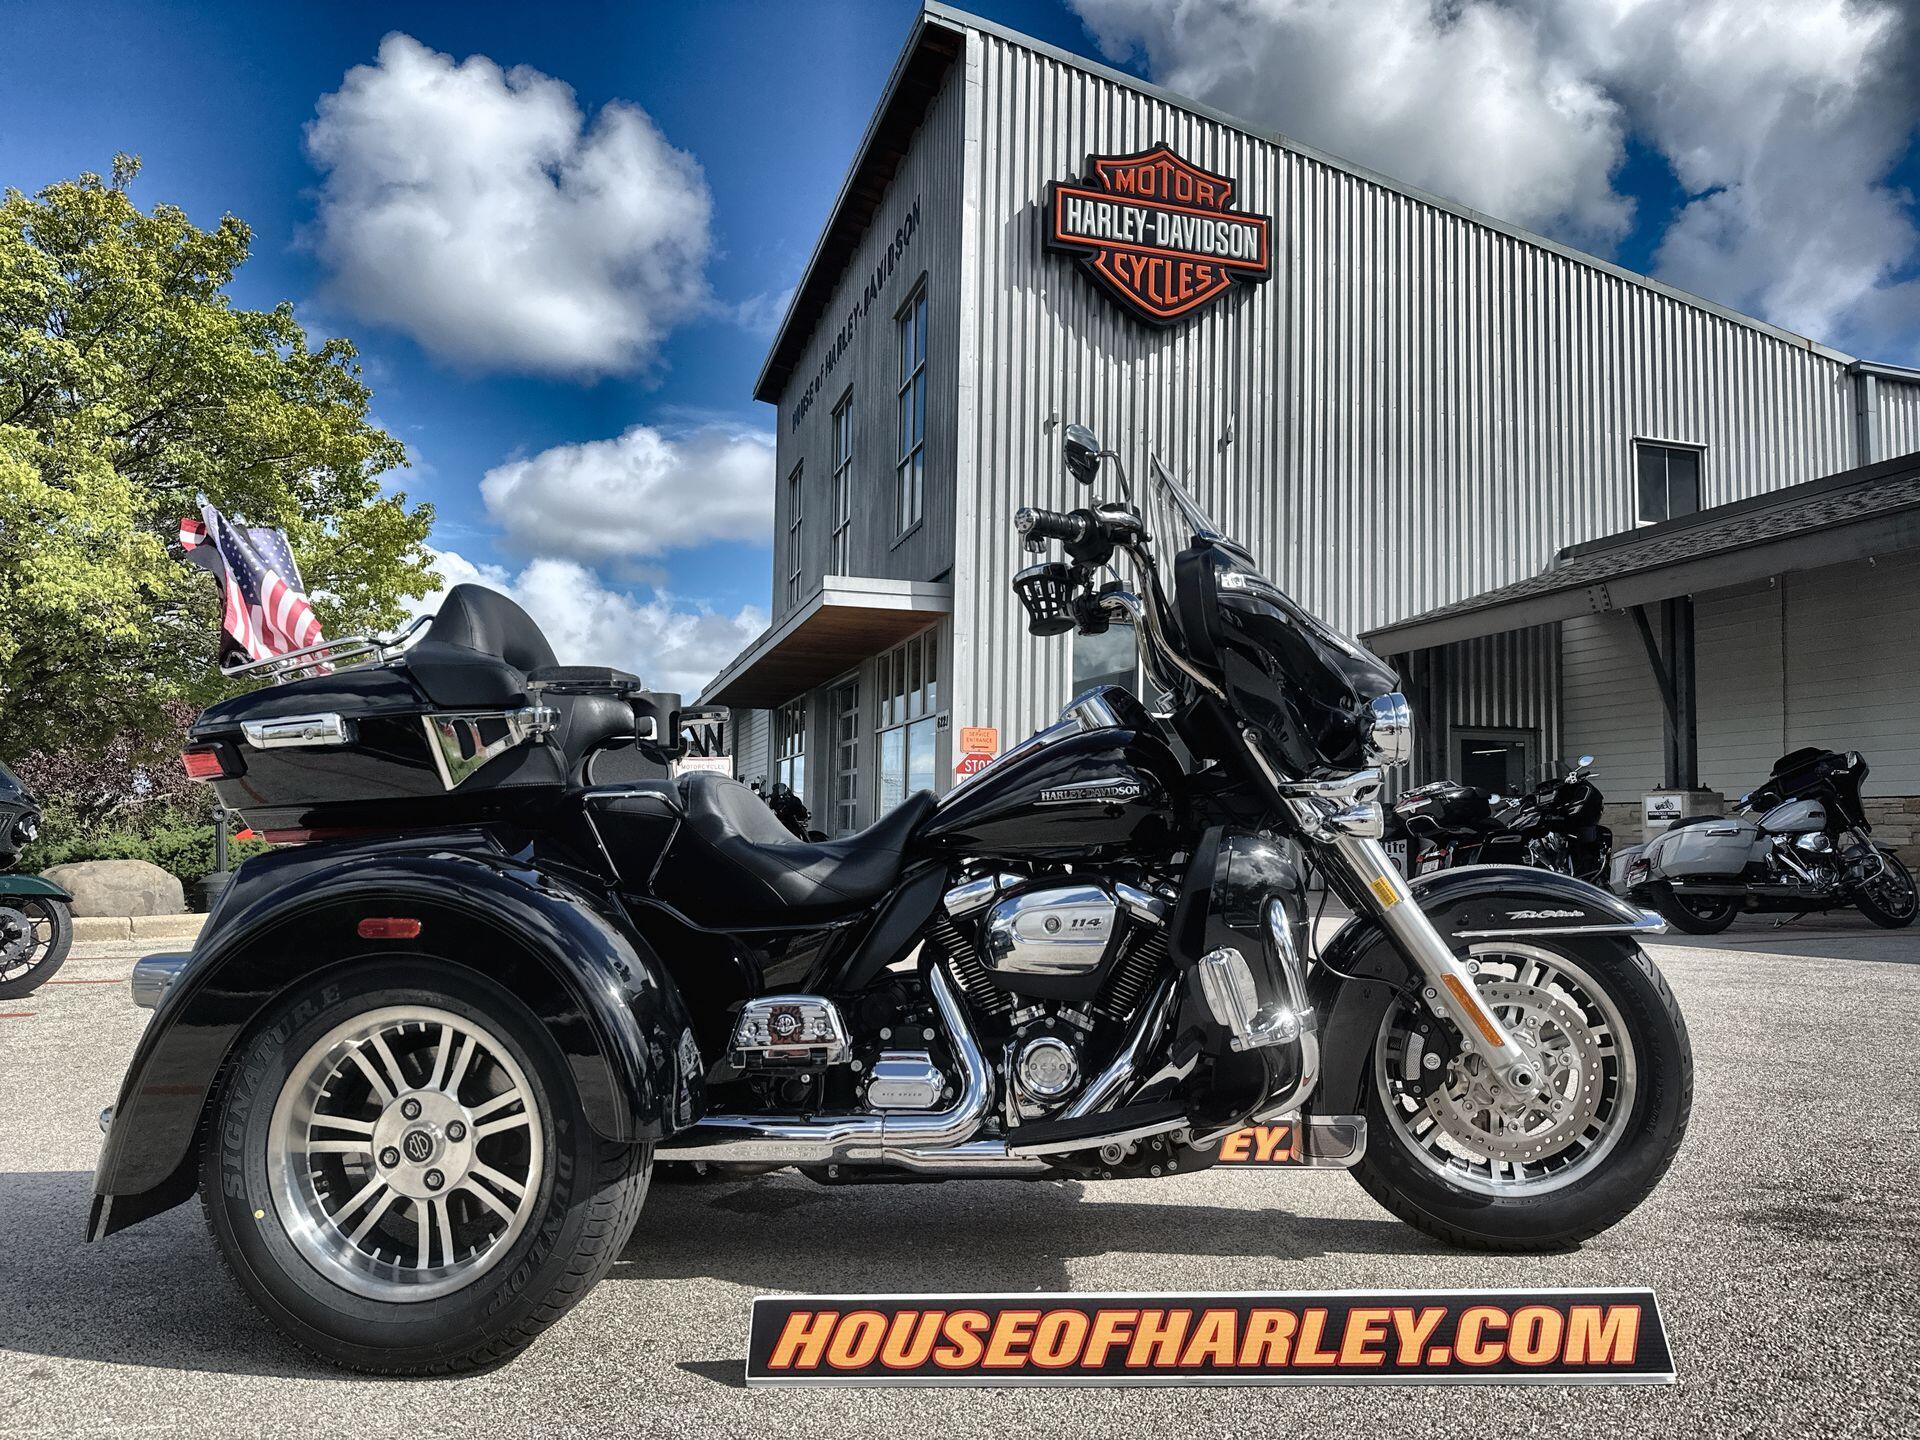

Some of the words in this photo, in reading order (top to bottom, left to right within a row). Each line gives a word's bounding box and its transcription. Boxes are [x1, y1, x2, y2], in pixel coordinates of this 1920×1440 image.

[1114, 160, 1215, 208] MOTOR
[1066, 197, 1258, 261] HARLEY-DAVIDSON
[825, 193, 922, 378] HARLEY-DAVIDSON
[1113, 252, 1213, 306] CYCLES
[1041, 785, 1140, 801] HARLEY-DAVIDSON
[1384, 841, 1406, 854] ite
[1071, 918, 1102, 928] 114
[222, 983, 342, 1200] SIGNATURE
[1219, 1126, 1292, 1162] EY.
[767, 1305, 1642, 1370] HOUSEOFHARLEY.COM
